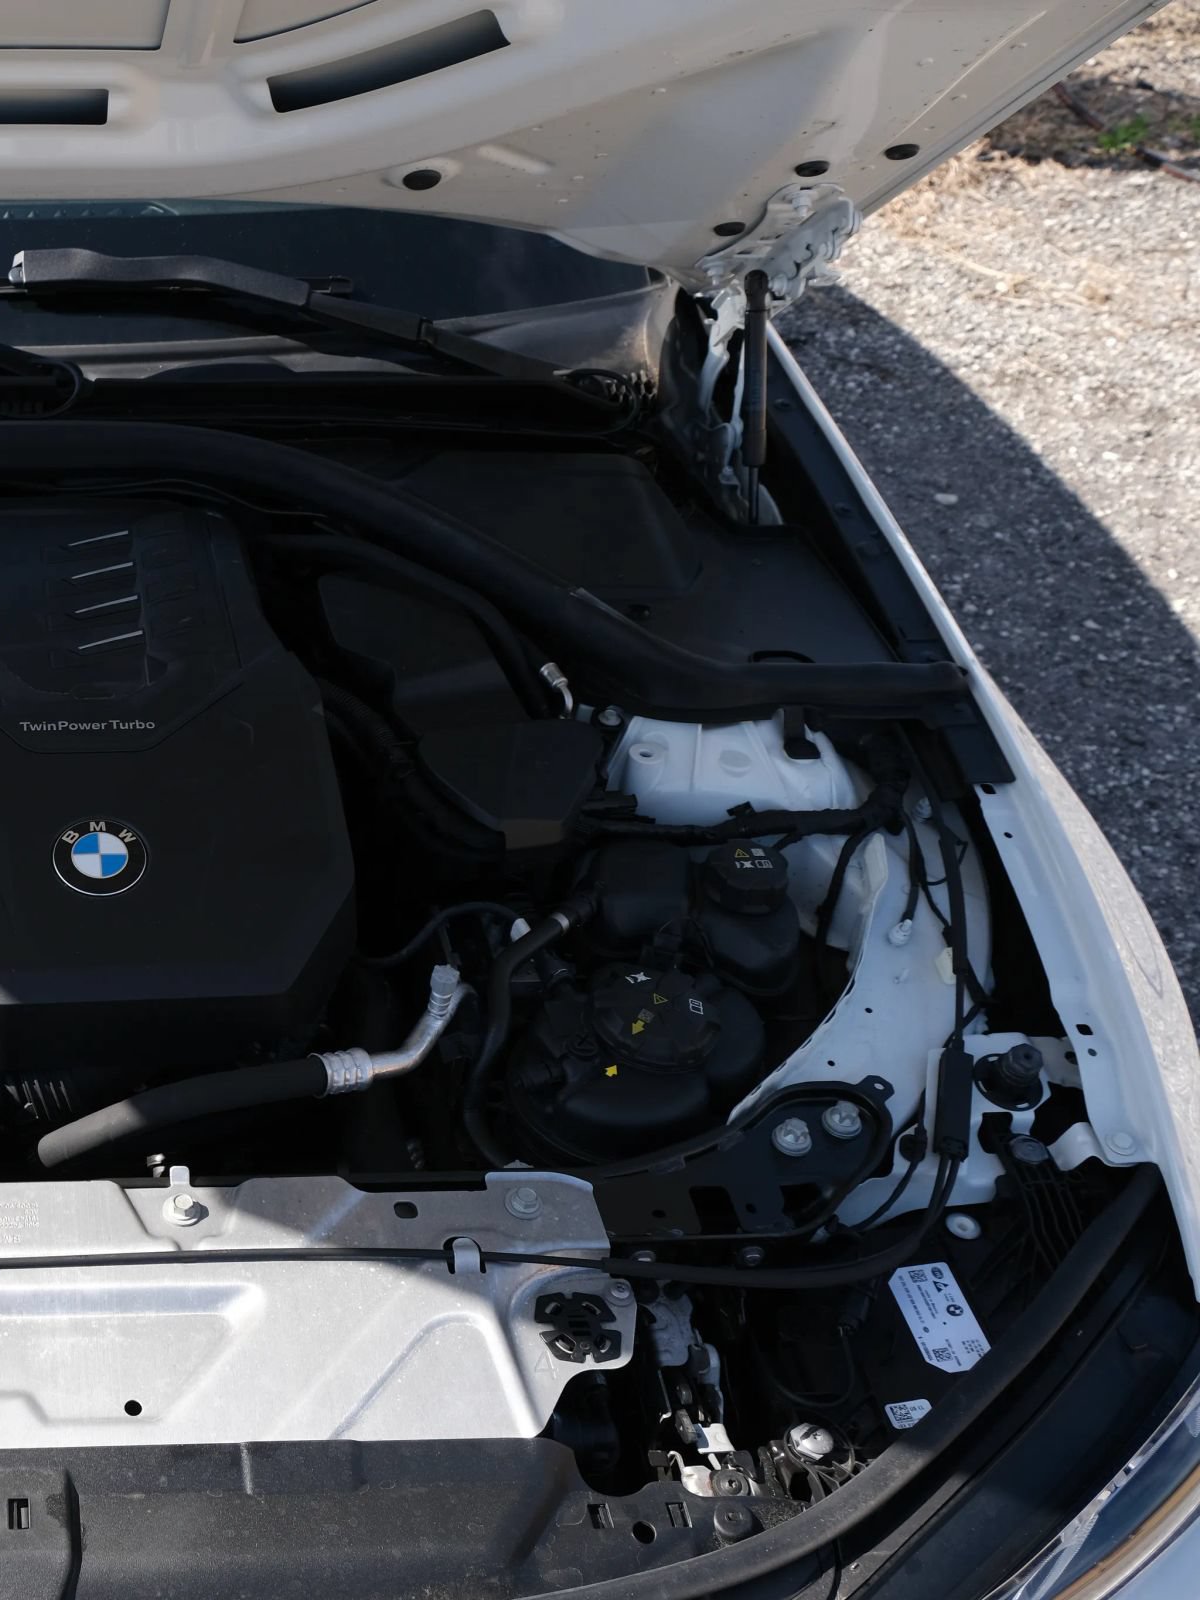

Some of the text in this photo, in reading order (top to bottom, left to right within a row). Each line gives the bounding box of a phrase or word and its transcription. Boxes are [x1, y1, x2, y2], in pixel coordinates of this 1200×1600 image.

[19, 719, 156, 732] TwinPower Turbo
[61, 821, 137, 845] BMW
